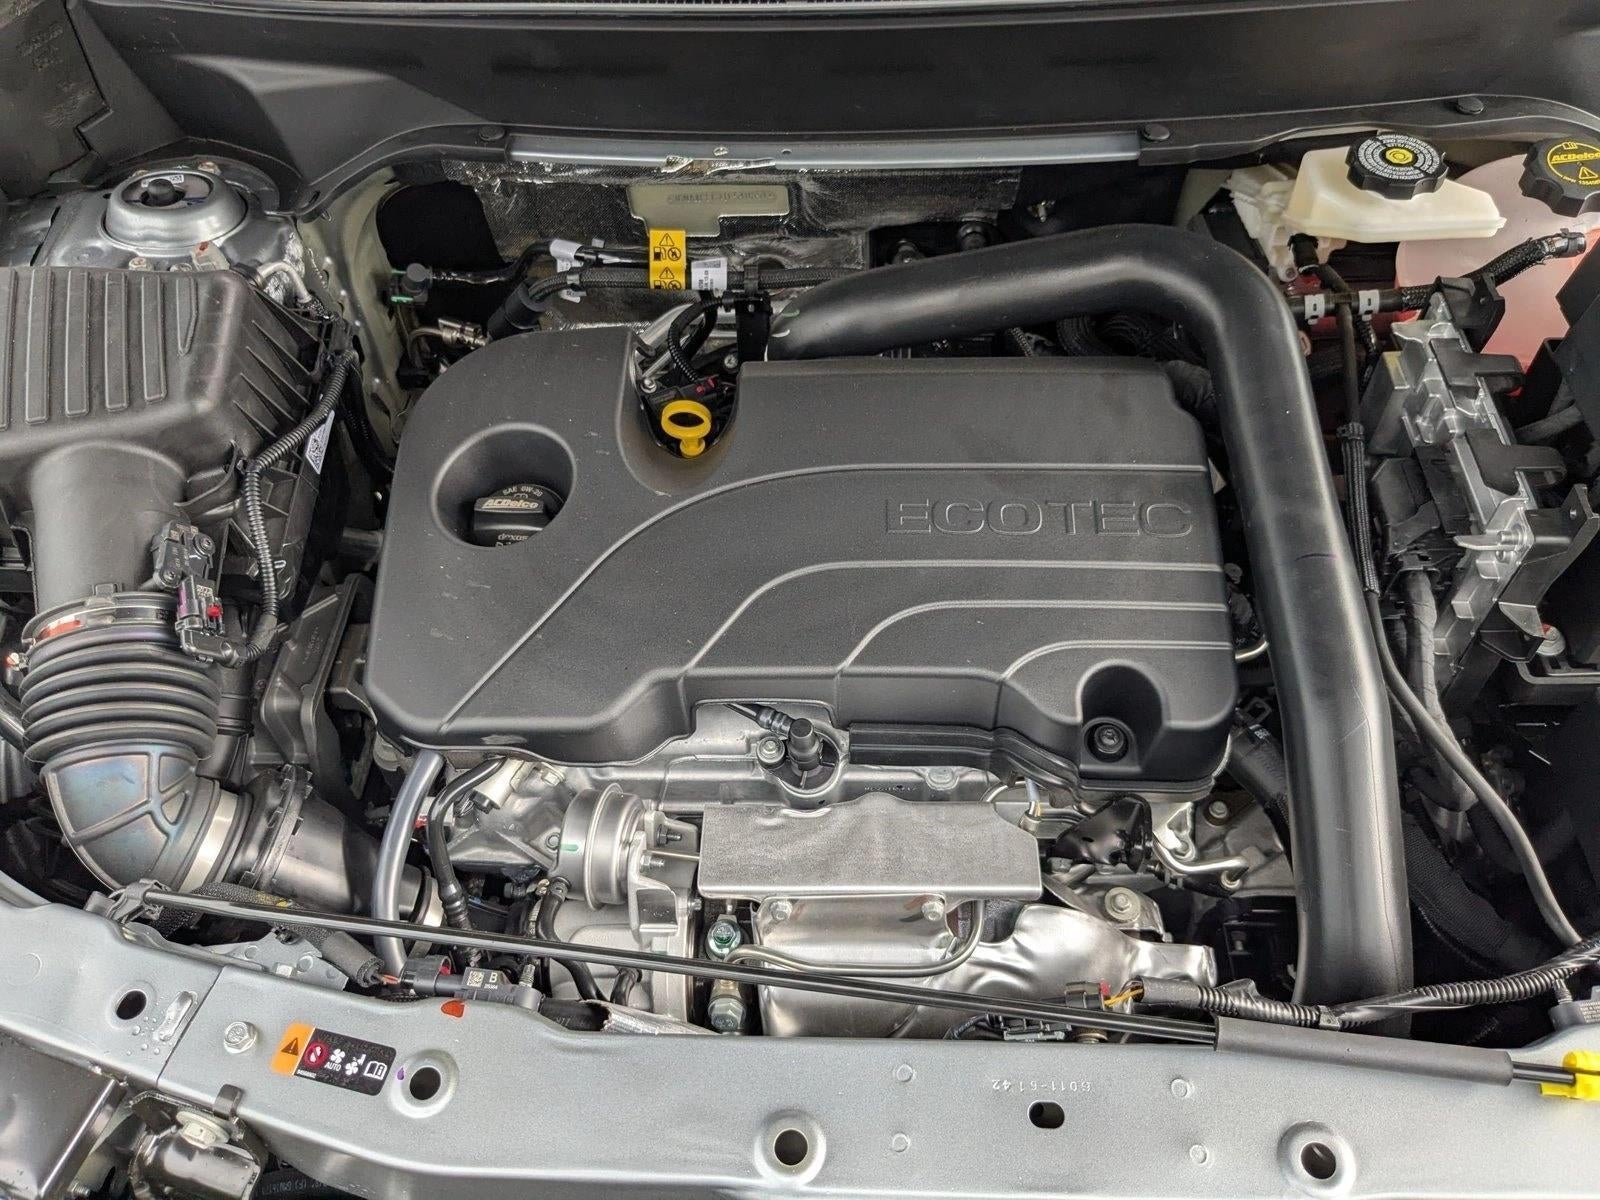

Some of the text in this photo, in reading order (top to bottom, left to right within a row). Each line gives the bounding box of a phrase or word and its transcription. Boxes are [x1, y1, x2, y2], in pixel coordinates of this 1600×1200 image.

[503, 486, 518, 496] SAE
[481, 499, 538, 509] ACDelco
[886, 498, 1195, 540] ECOTEC
[489, 971, 498, 983] B
[324, 1061, 342, 1073] AUTO
